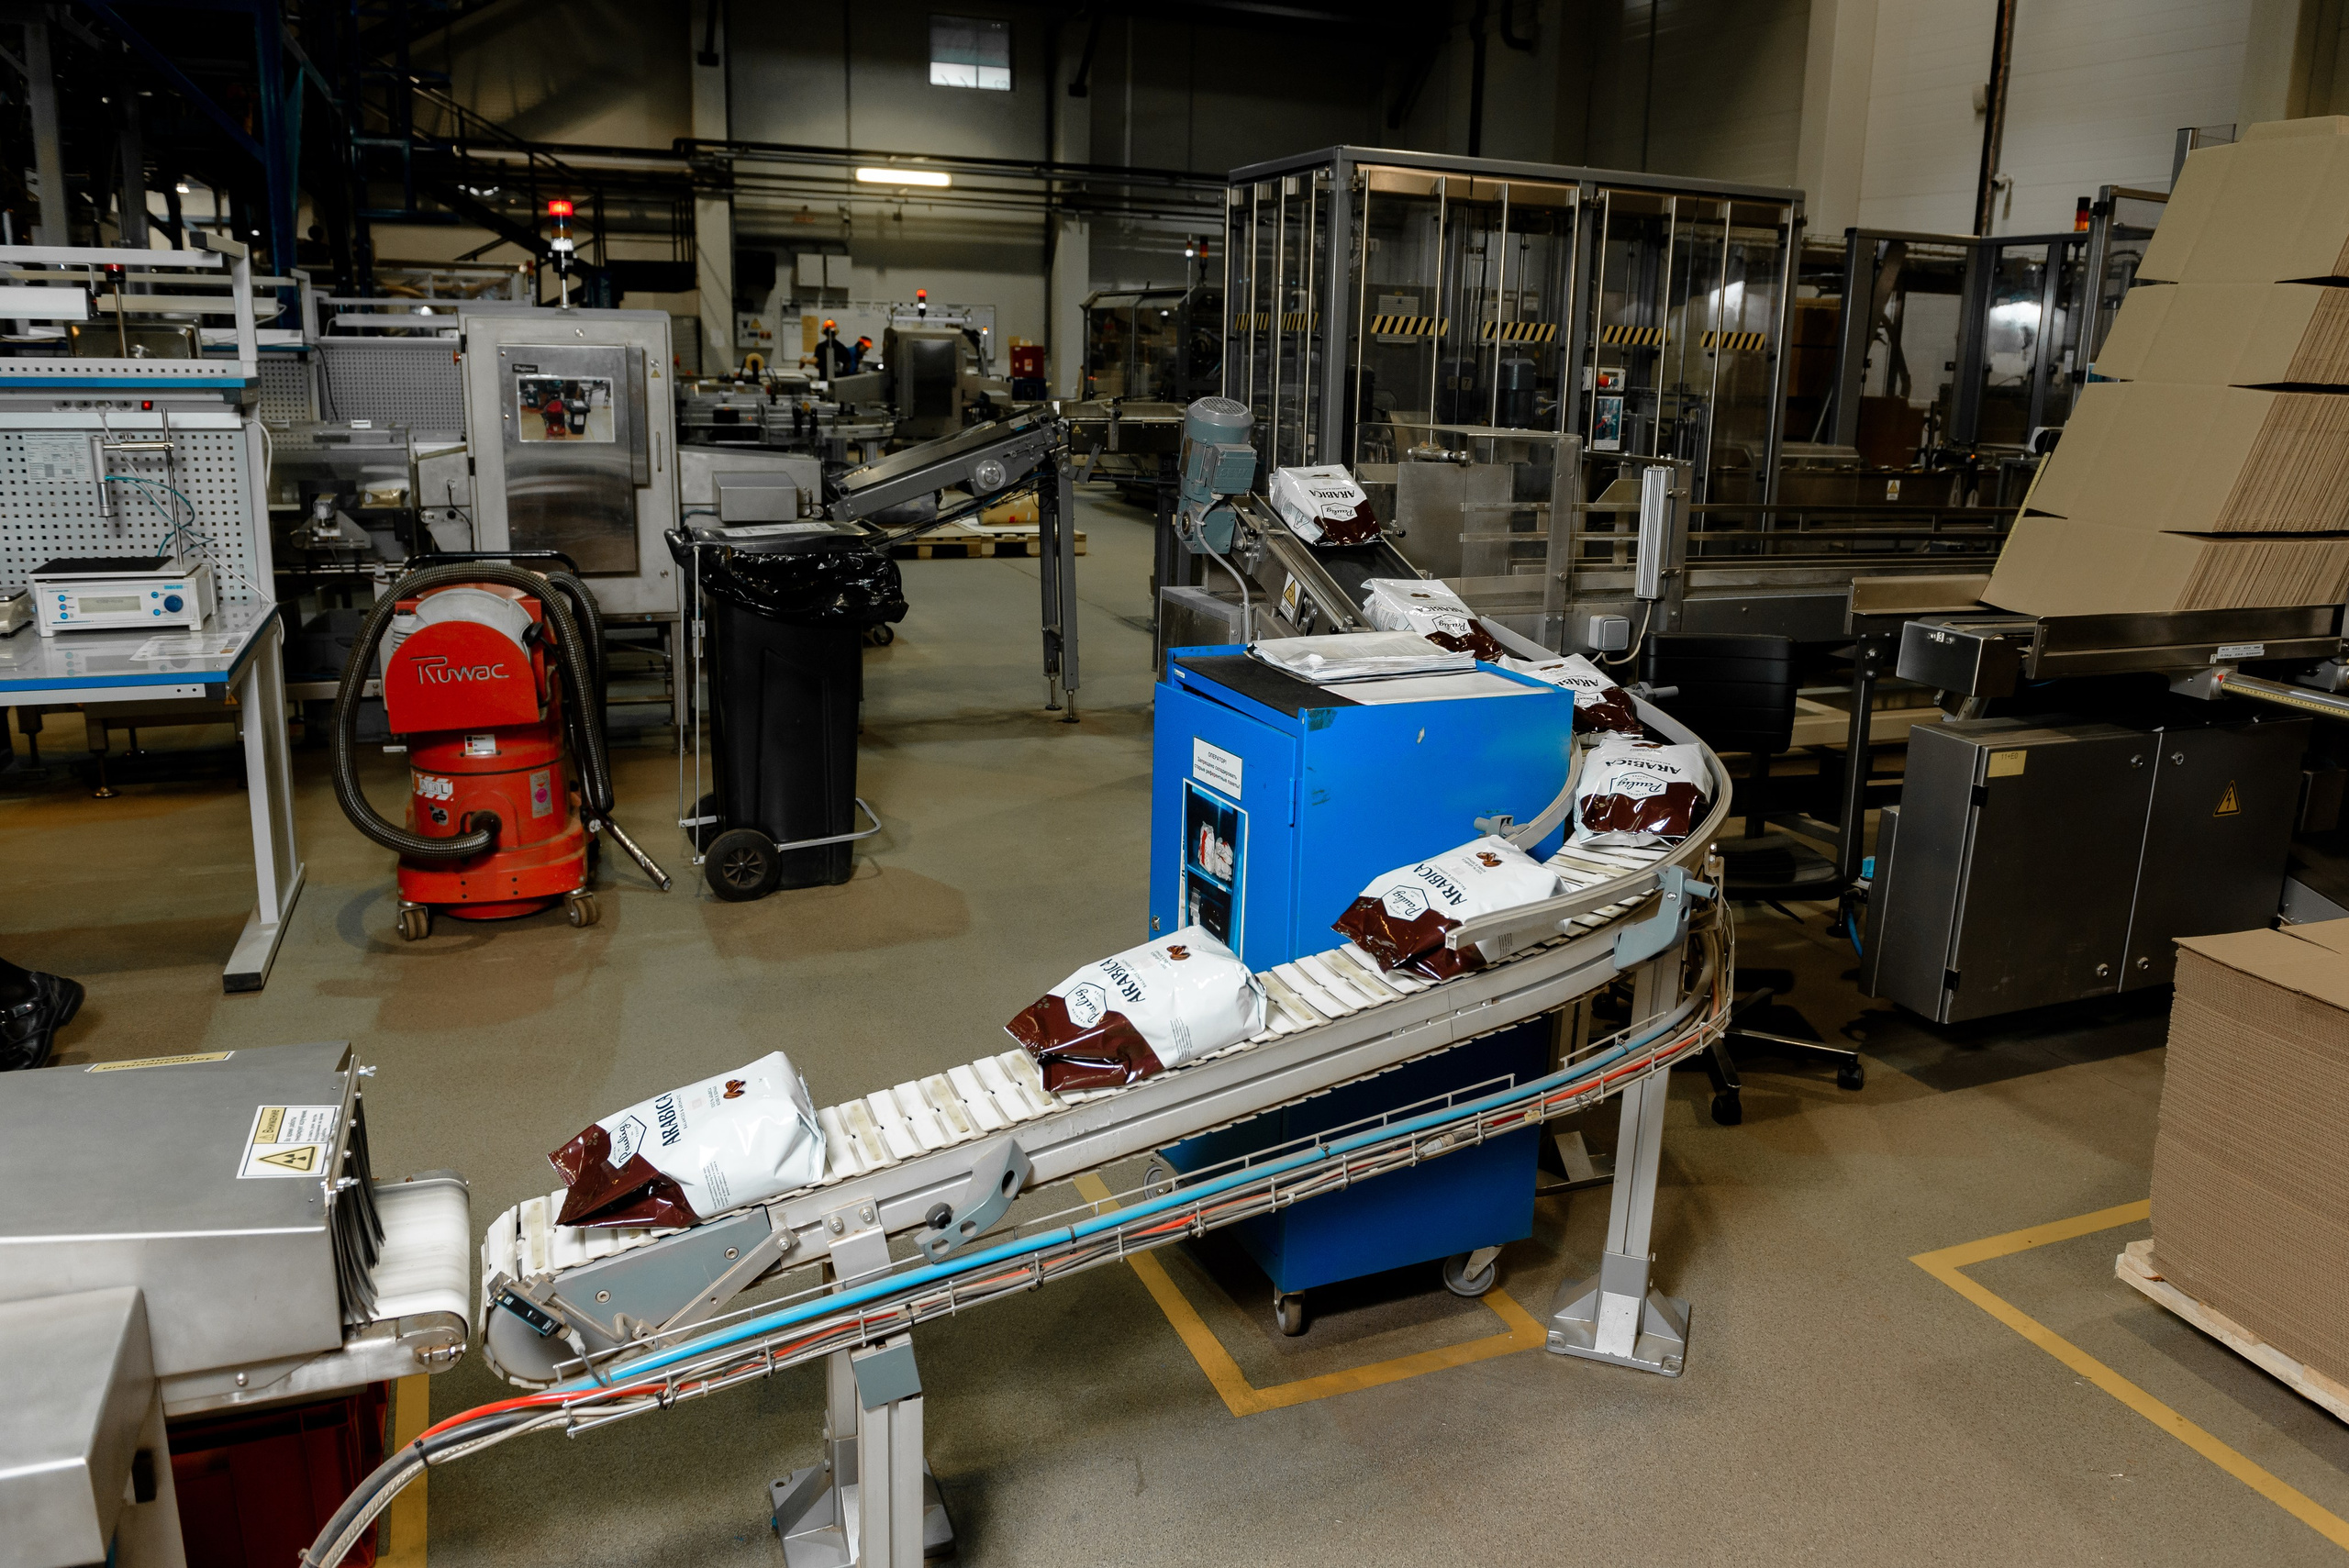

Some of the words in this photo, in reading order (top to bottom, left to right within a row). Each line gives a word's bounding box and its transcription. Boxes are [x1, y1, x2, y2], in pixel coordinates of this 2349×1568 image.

[1308, 490, 1354, 498] ARABICA
[1326, 507, 1353, 517] Paulig
[409, 655, 509, 684] Ruwac
[1605, 759, 1681, 774] ARABICA
[1616, 778, 1663, 793] Paulig
[1413, 863, 1467, 906] ARABICA
[1393, 890, 1421, 917] Paulig
[1099, 958, 1145, 1003] ARABICA
[1075, 988, 1100, 1023] Paulig
[262, 1108, 280, 1132] Внимание
[655, 1093, 682, 1147] ARABICA
[618, 1123, 631, 1163] Paulig
